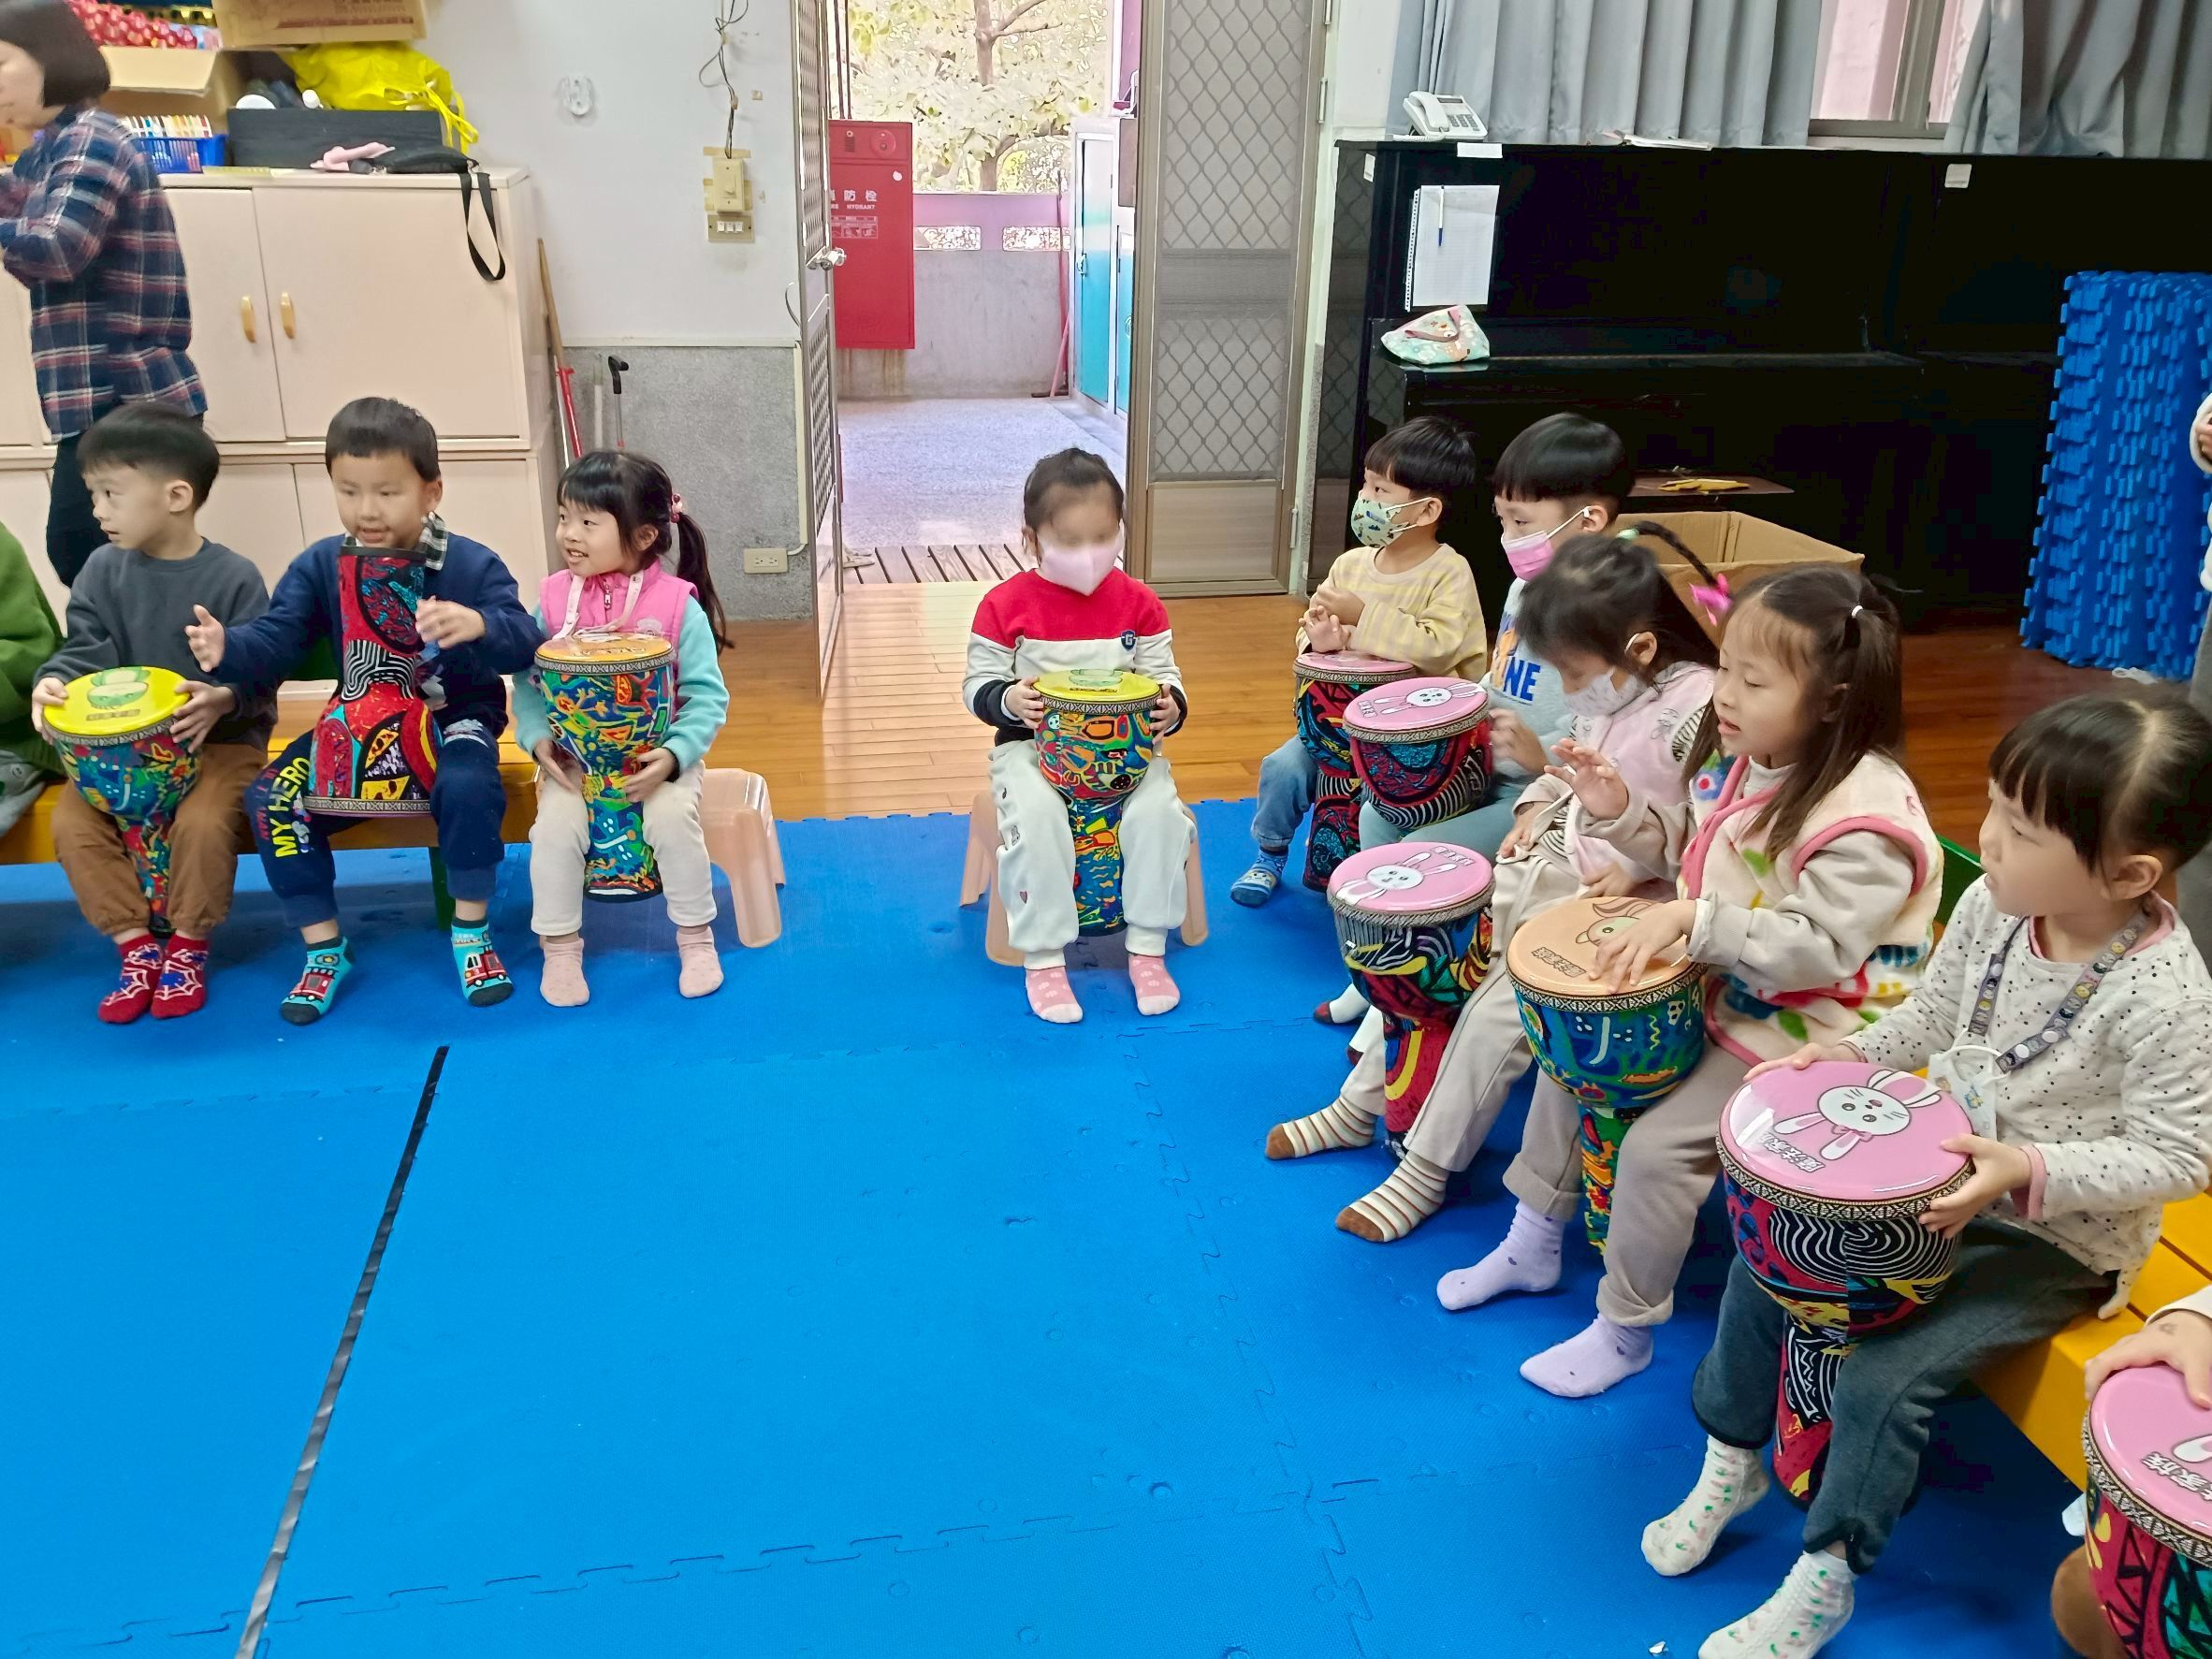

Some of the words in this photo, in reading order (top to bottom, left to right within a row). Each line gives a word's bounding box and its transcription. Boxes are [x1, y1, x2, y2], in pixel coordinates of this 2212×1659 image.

[831, 189, 877, 201] 防栓
[268, 757, 311, 812] HERO
[269, 818, 298, 858] MY
